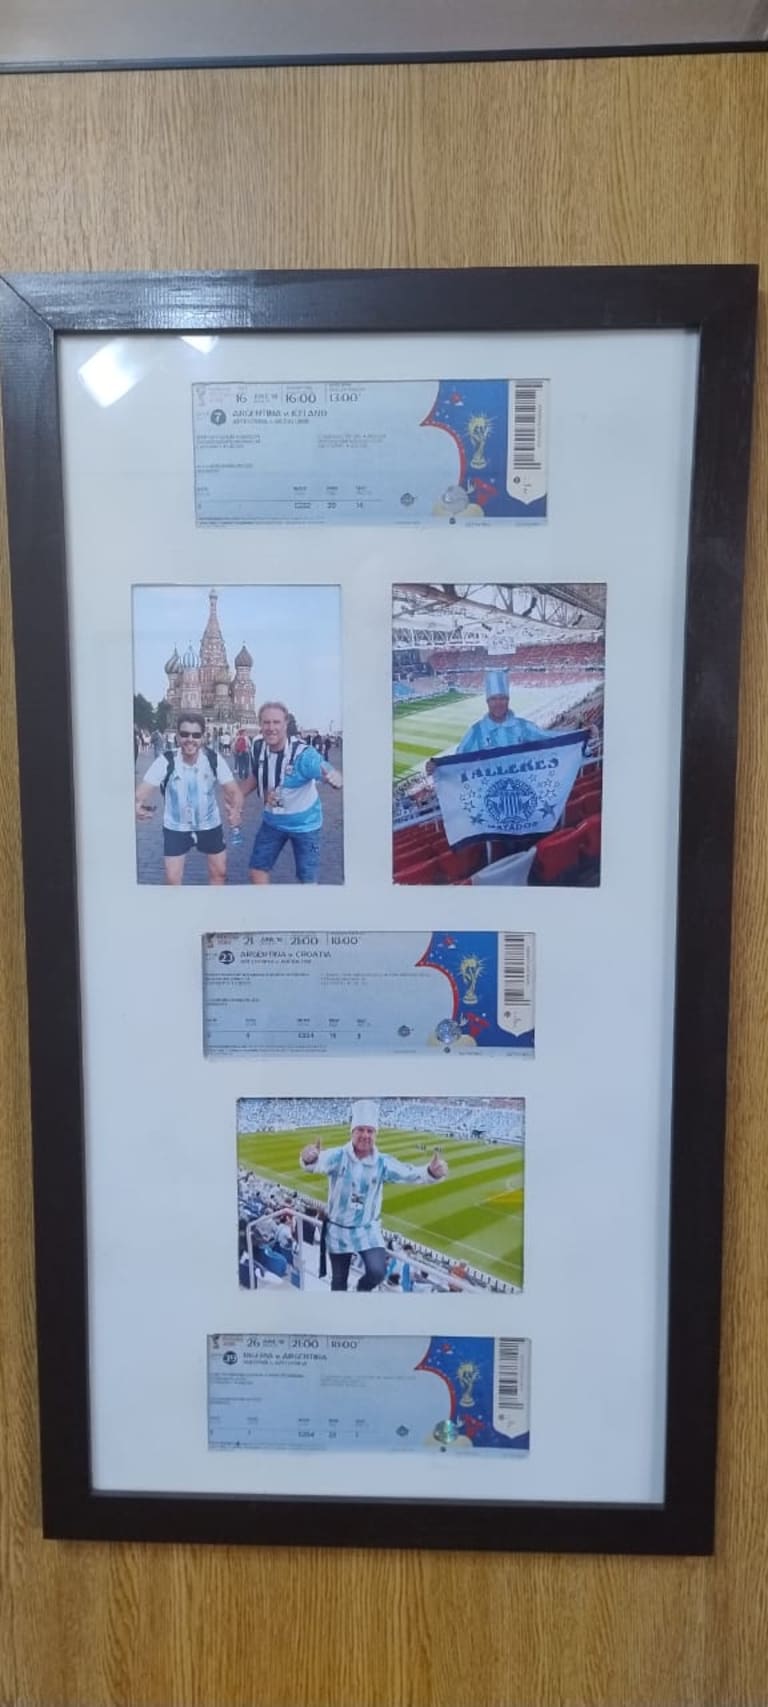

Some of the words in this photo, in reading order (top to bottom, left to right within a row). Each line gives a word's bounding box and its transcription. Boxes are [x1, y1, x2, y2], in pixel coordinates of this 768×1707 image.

[236, 392, 248, 404] 16
[232, 408, 281, 417] ARGENTINA
[244, 936, 254, 945] 21
[239, 950, 287, 958] ARGENTINA
[295, 950, 332, 958] CROATIA
[246, 1337, 260, 1347] 26
